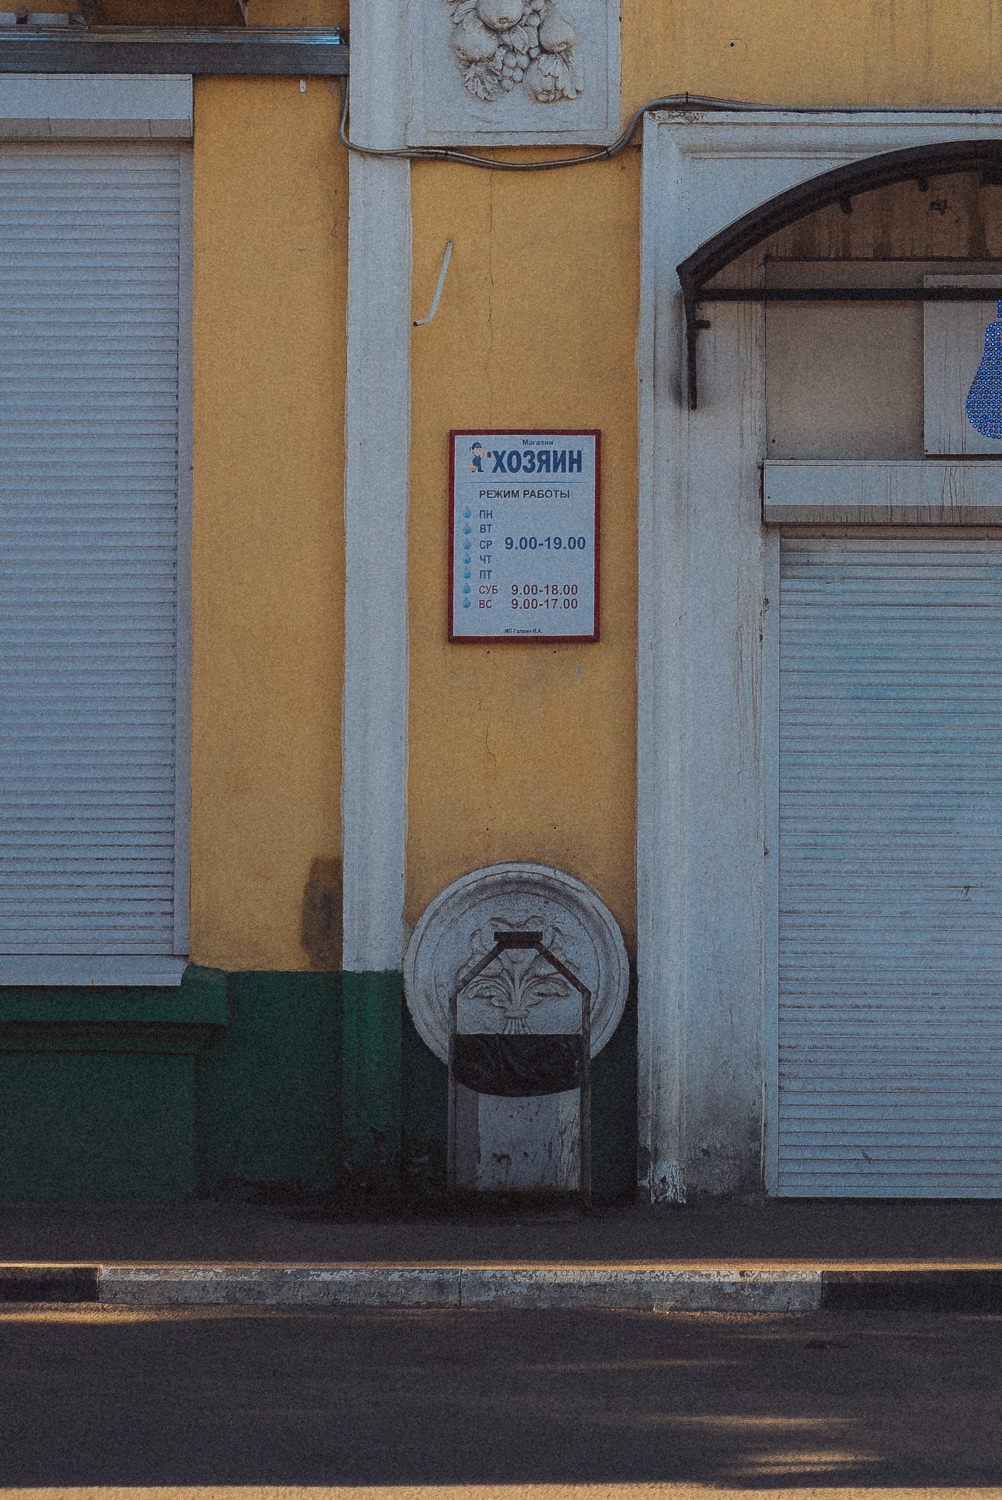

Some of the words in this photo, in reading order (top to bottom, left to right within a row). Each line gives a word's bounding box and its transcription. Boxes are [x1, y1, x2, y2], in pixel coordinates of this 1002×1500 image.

[491, 449, 583, 473] ХОЗЯИН
[479, 490, 520, 499] РЕЖИМ
[522, 490, 571, 499] РАБОТЫ
[479, 510, 493, 519] ПН
[479, 524, 493, 533] ВТ
[479, 540, 493, 550] СР
[504, 536, 586, 550] 9.00-19.00
[479, 555, 493, 564] ЧТ
[479, 570, 493, 579] ПТ
[479, 585, 499, 595] СУБ
[511, 584, 579, 596] 9.00-18.00
[479, 599, 493, 609] ВС
[511, 598, 579, 609] 9.00-17.00
